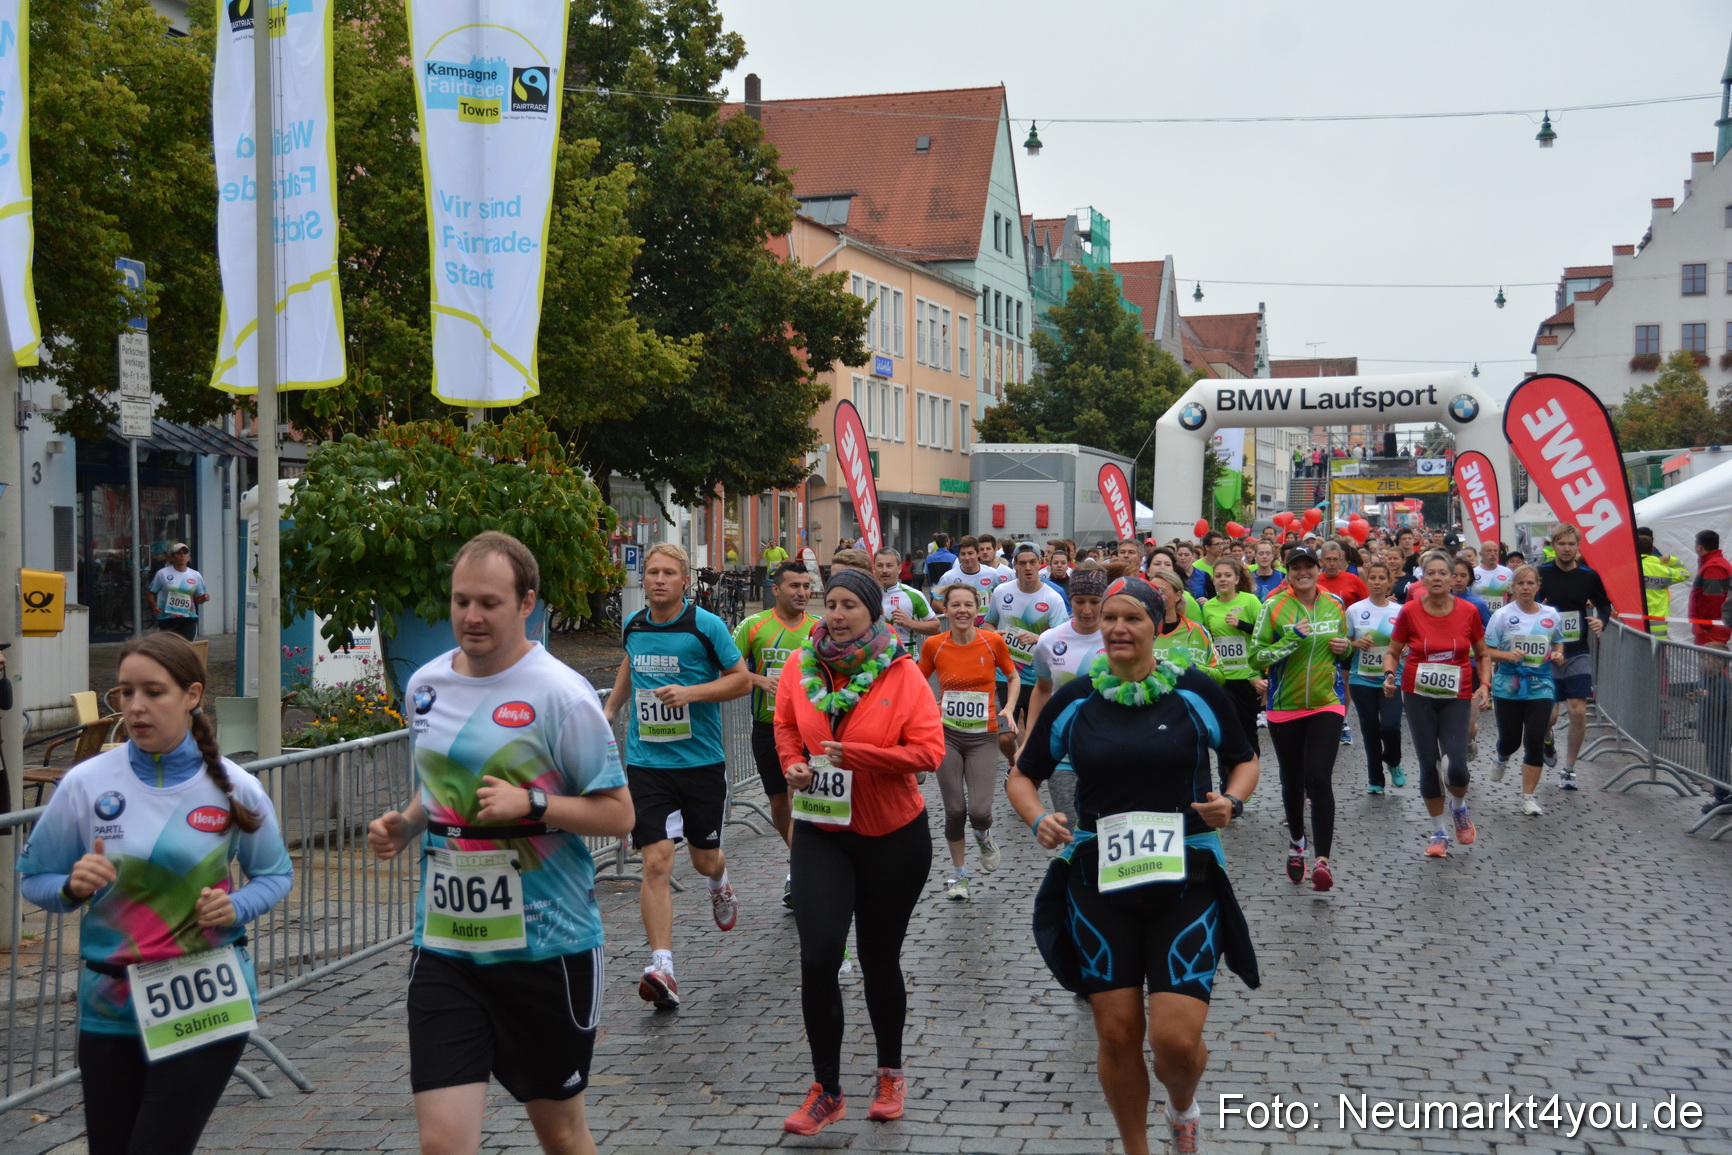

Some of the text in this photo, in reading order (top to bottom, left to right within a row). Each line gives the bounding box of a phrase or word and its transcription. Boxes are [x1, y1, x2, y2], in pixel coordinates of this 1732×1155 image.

[427, 63, 497, 83] Kampagne
[428, 77, 505, 98] Fairtrade
[460, 102, 499, 117] Towns
[513, 103, 547, 112] FAIRTRADE
[479, 195, 521, 219] sind
[122, 345, 147, 357] Parkschein
[125, 358, 146, 369] werktags
[1217, 384, 1438, 412] BMW Laufsport
[32, 461, 42, 485] 3
[1376, 481, 1403, 491] ZIEL
[627, 550, 635, 561] P
[169, 596, 190, 608] 3095
[1484, 601, 1502, 610] 186
[634, 655, 679, 667] HUBER
[1420, 671, 1456, 689] 5085
[498, 706, 531, 722] Hervis
[640, 702, 684, 722] 5100
[946, 700, 985, 718] 5090
[648, 726, 676, 735] Thomas
[799, 770, 845, 797] 048
[802, 800, 831, 814] Monika
[193, 811, 228, 827] Hervis
[1132, 814, 1175, 824] BOCK
[1107, 828, 1175, 862] 5147
[456, 854, 508, 867] BOCK
[1117, 860, 1163, 878] Susanne
[433, 872, 512, 913] 5064
[452, 922, 488, 938] Andre
[146, 963, 238, 1018] 5069
[174, 1011, 230, 1037] Sabrina
